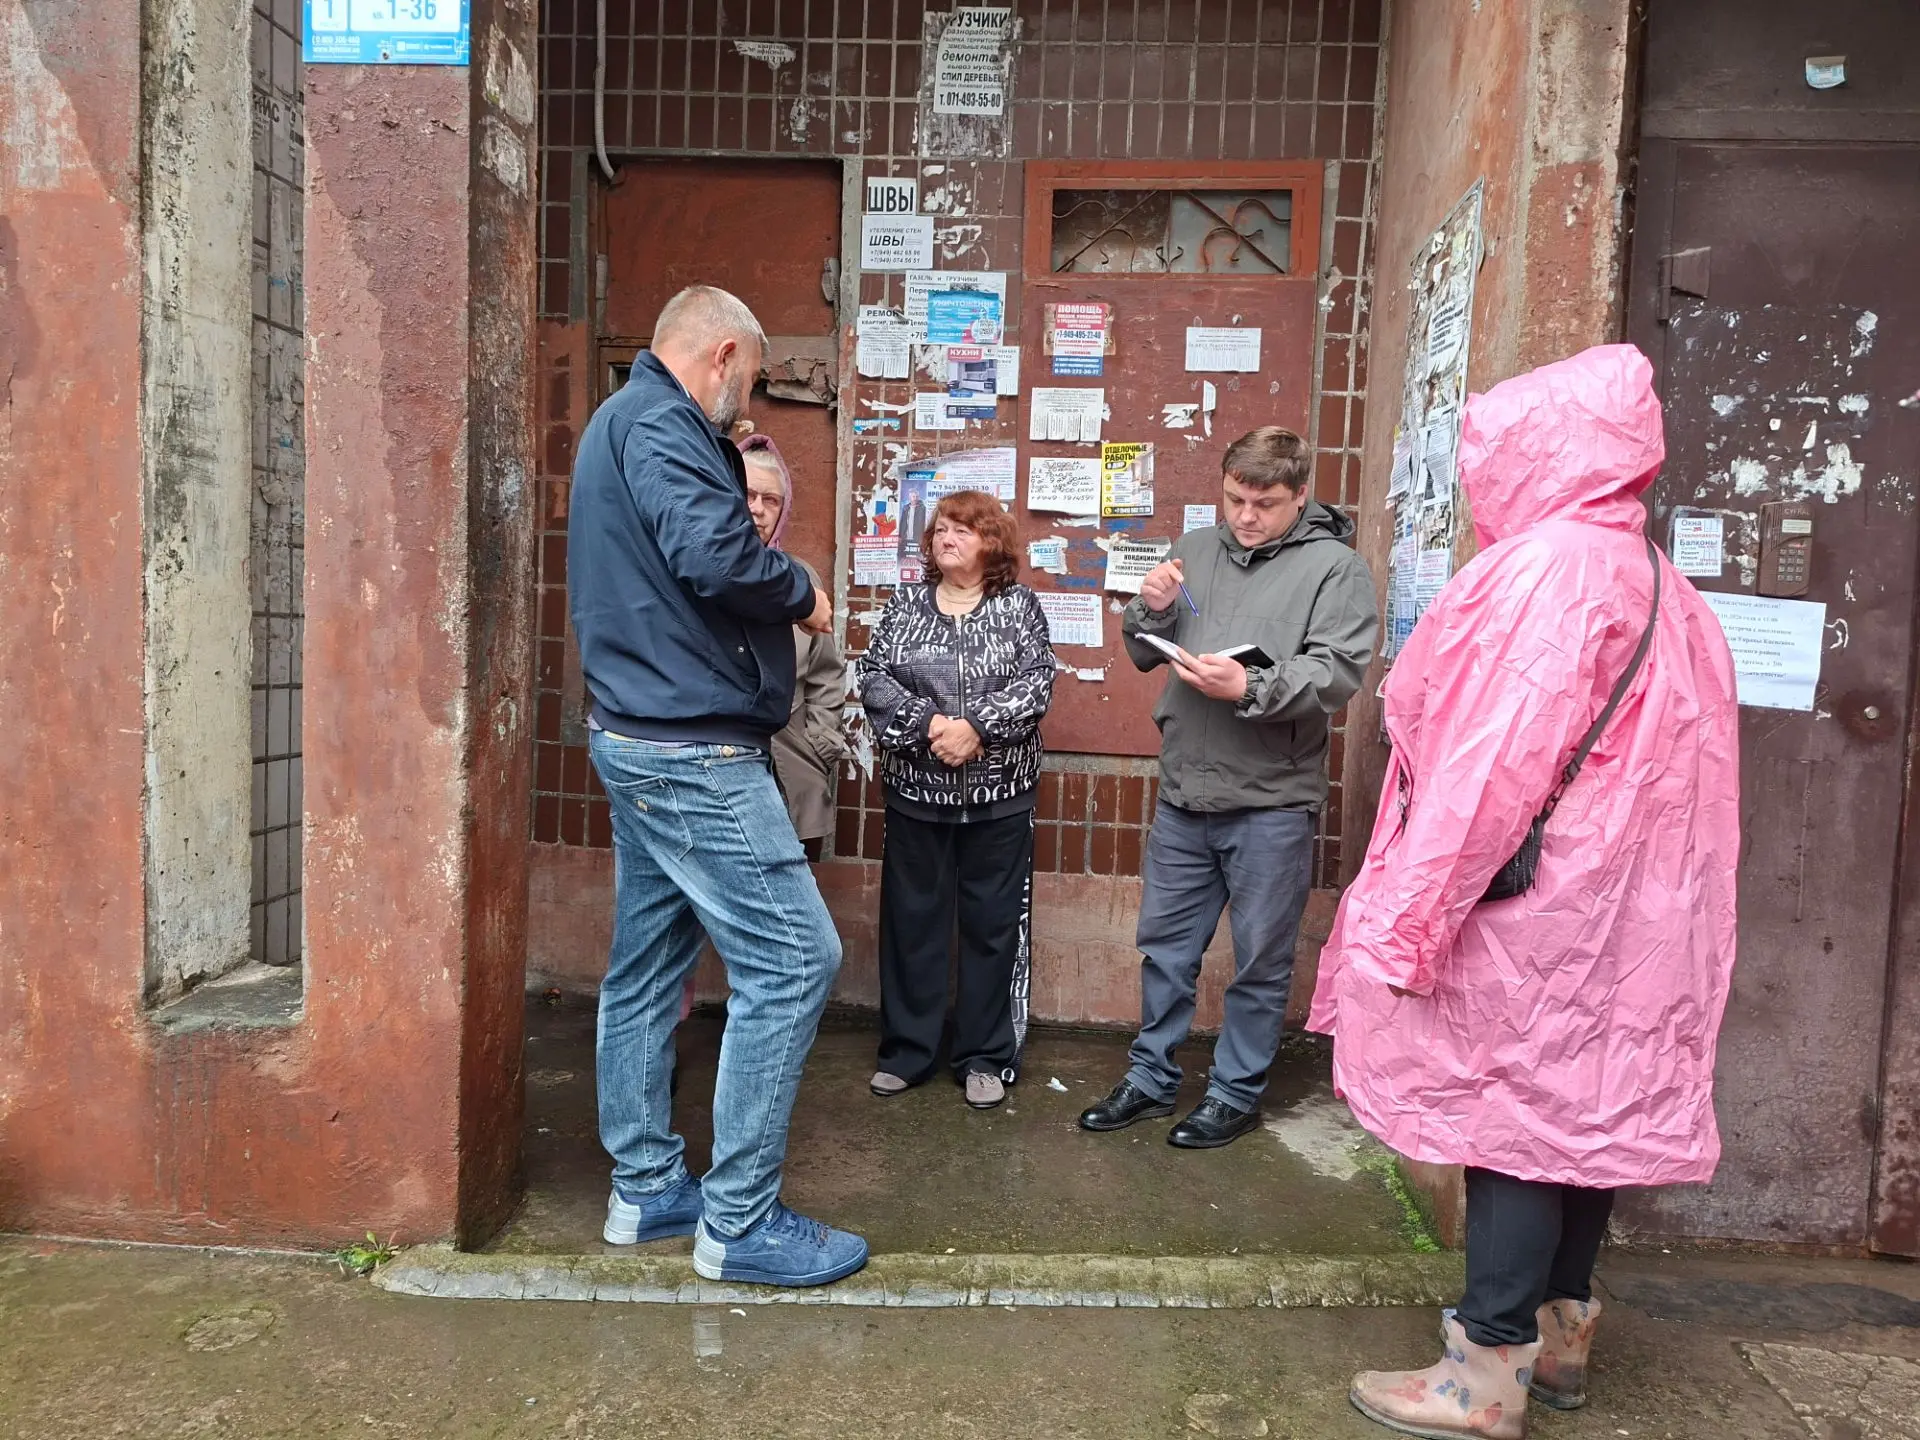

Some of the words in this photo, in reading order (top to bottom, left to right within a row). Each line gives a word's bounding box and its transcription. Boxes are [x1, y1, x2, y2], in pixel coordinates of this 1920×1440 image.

[941, 72, 962, 81] СПИЛ
[868, 186, 914, 212] ШВЫ
[869, 235, 905, 247] ШВЫ
[1057, 304, 1103, 315] ПОМОЩЬ
[910, 331, 929, 341] +7(9
[949, 348, 980, 356] КУХНИ
[1104, 444, 1148, 454] ОТДЕЛОЧНЫЕ
[1104, 453, 1136, 462] РАБОТЫ
[1681, 519, 1702, 527] Окна
[1112, 545, 1157, 554] ОБСЛУЖИВАНИЕ
